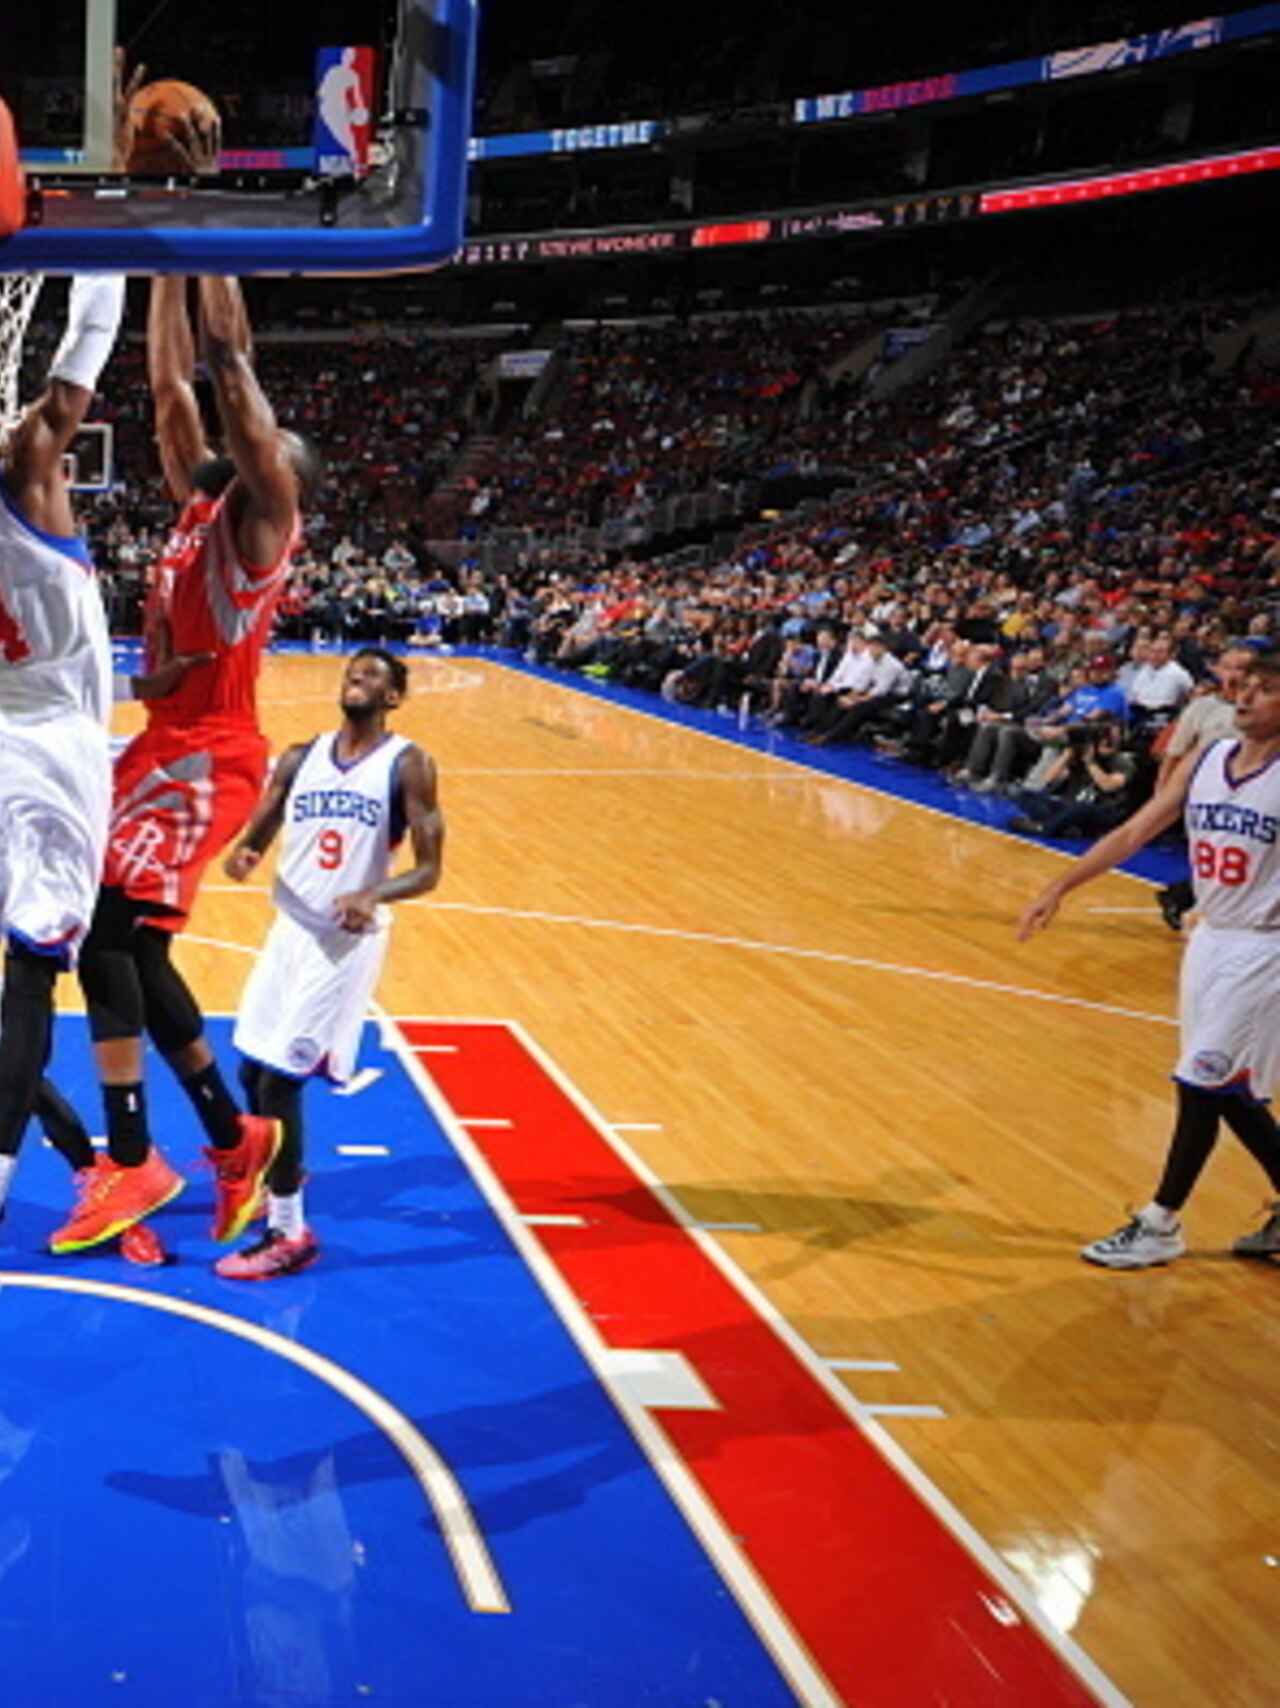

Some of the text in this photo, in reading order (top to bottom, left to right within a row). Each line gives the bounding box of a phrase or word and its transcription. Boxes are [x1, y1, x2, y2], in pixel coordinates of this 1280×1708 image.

[817, 91, 853, 119] WE
[863, 74, 956, 113] DEFEND
[550, 120, 653, 152] TOGETHE
[539, 238, 594, 256] STEVIE
[596, 232, 675, 253] WONDER
[293, 789, 381, 827] SIXERS
[317, 828, 343, 871] 9
[1194, 840, 1250, 887] 88
